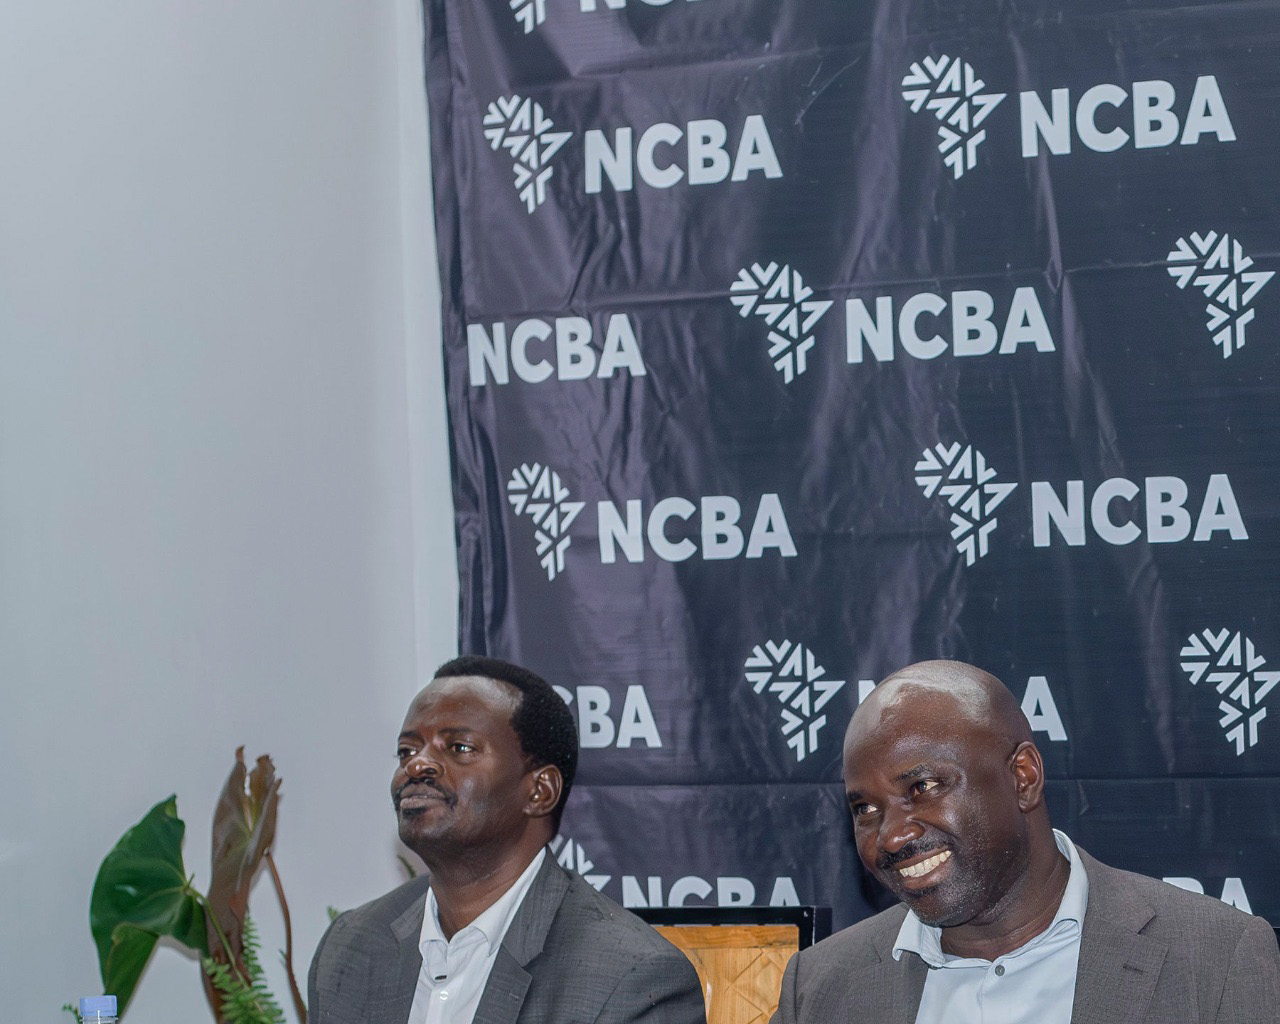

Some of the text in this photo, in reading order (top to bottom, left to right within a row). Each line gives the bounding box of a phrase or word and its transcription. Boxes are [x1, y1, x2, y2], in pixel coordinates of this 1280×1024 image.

[584, 114, 783, 194] NCBA
[1019, 75, 1237, 158] NCBA
[466, 313, 647, 387] NCBA
[845, 286, 1056, 364] NCBA
[597, 493, 798, 564] NCBA
[1031, 473, 1249, 548] NCBA
